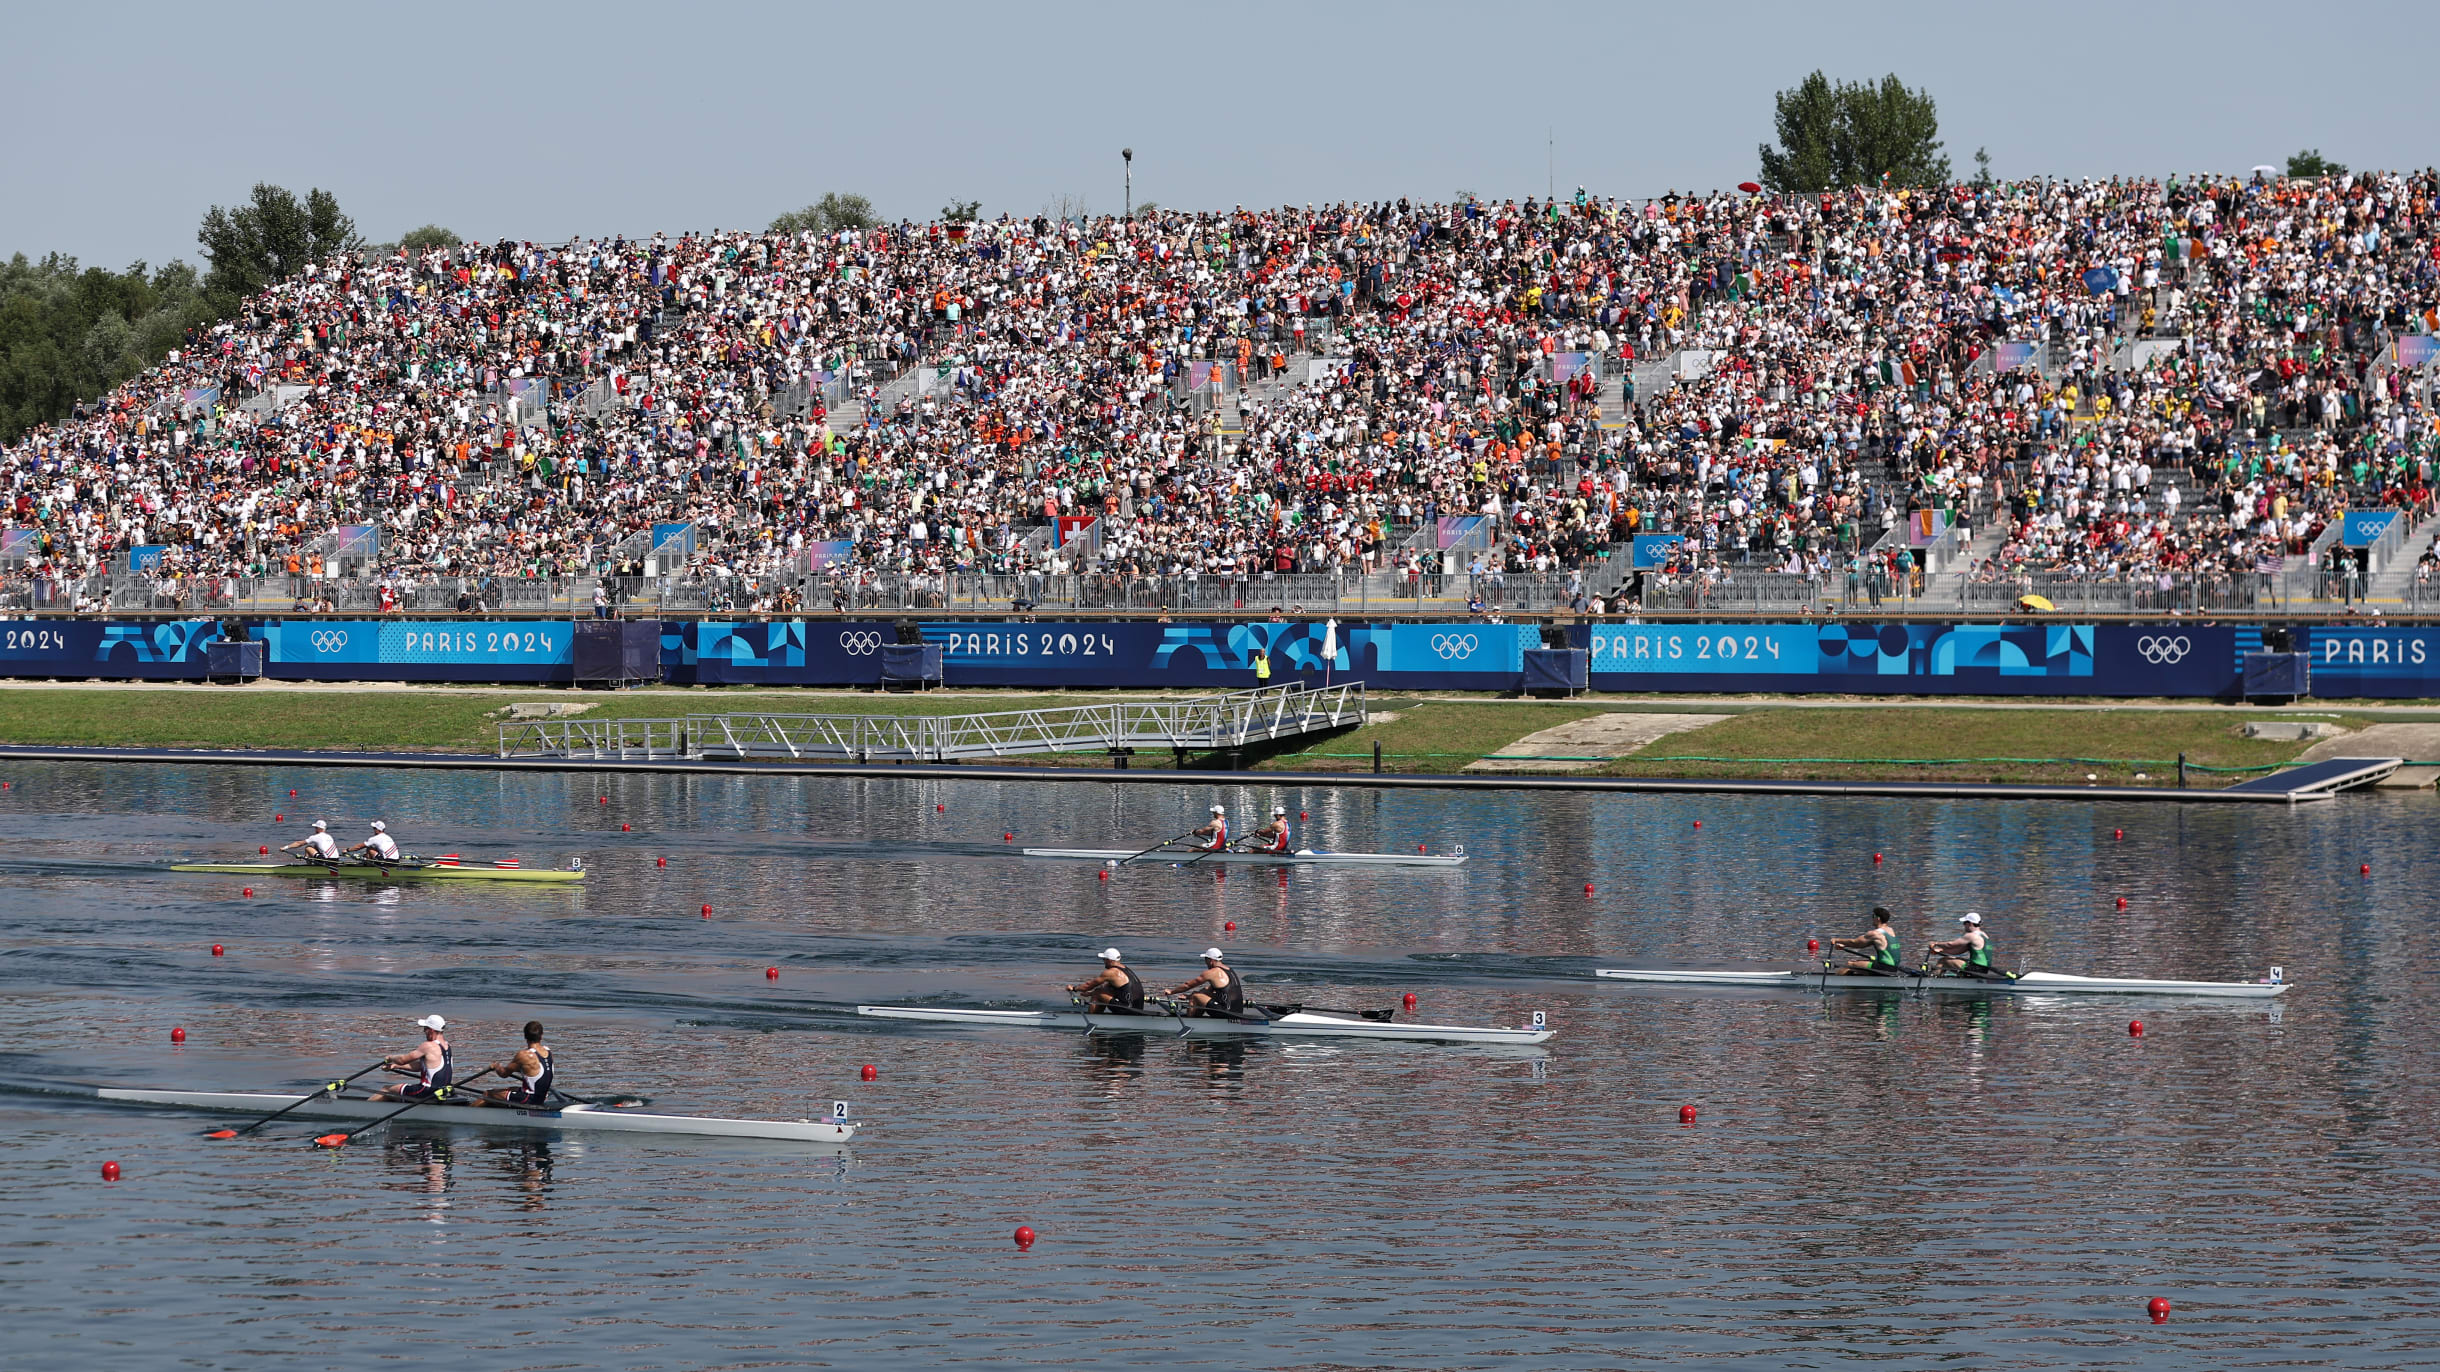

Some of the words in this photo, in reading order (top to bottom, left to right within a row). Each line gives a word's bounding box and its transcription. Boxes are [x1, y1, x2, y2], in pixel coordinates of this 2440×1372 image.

[6, 630, 64, 649] 2024
[487, 632, 552, 652] 2024
[1041, 633, 1114, 655] 2024
[1697, 636, 1779, 659] 2024
[573, 858, 579, 867] 5
[2272, 968, 2280, 979] 4
[1535, 1013, 1543, 1024] 3
[836, 1103, 845, 1117] 2
